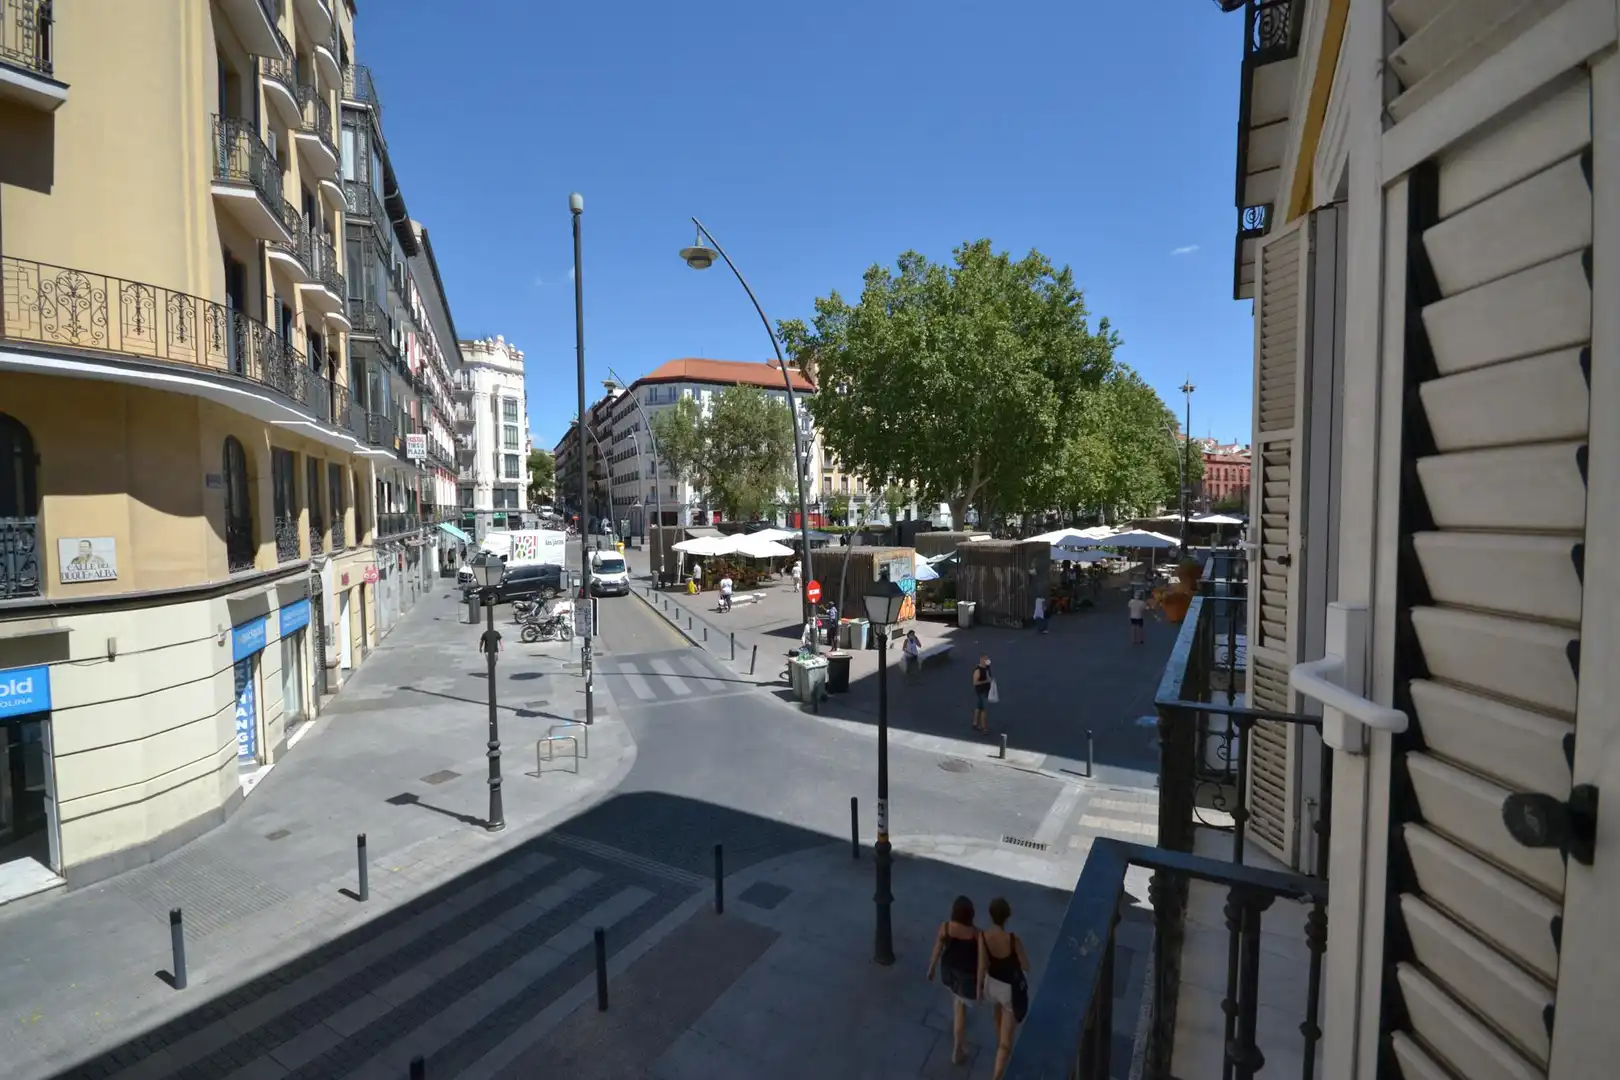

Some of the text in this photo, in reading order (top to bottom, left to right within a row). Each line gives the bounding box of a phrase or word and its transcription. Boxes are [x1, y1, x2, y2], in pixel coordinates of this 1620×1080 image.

[66, 563, 96, 571] CALLE
[60, 571, 88, 580] DUQUE
[95, 569, 118, 578] ALBA
